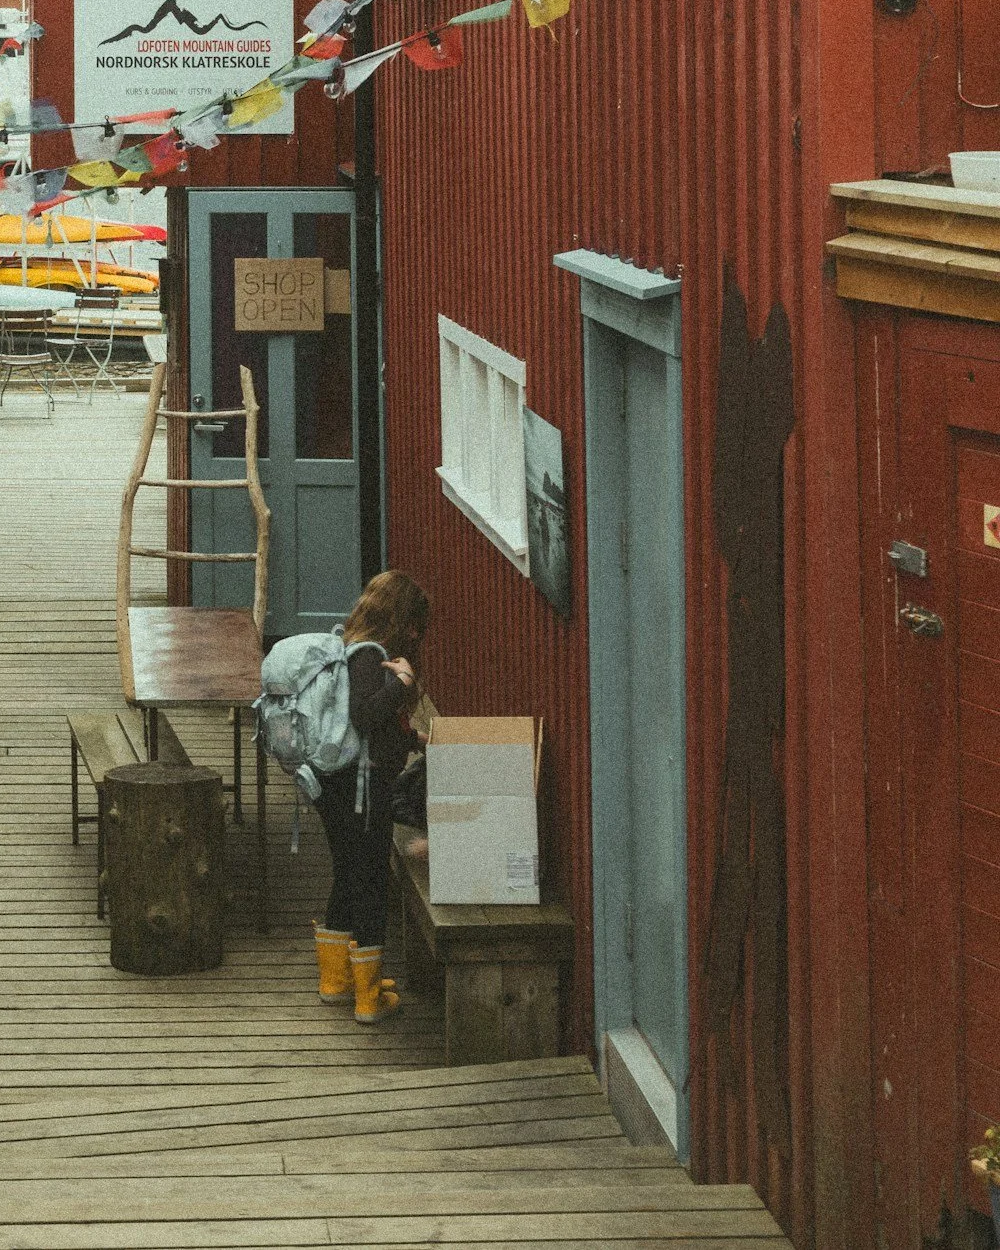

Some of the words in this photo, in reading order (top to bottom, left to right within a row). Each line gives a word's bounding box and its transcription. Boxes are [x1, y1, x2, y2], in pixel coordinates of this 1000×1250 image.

[137, 40, 180, 53] LOFOTEN
[182, 40, 234, 53] MOUNTAIN
[236, 40, 271, 53] GUIDES
[96, 56, 179, 68] NORDNORSK
[182, 56, 271, 68] KLATRESKOLE
[125, 87, 143, 96] KURS
[151, 87, 178, 96] GUIDING
[188, 87, 212, 96] UTSTYR
[243, 272, 316, 295] SHOP
[243, 298, 317, 321] OPEN
